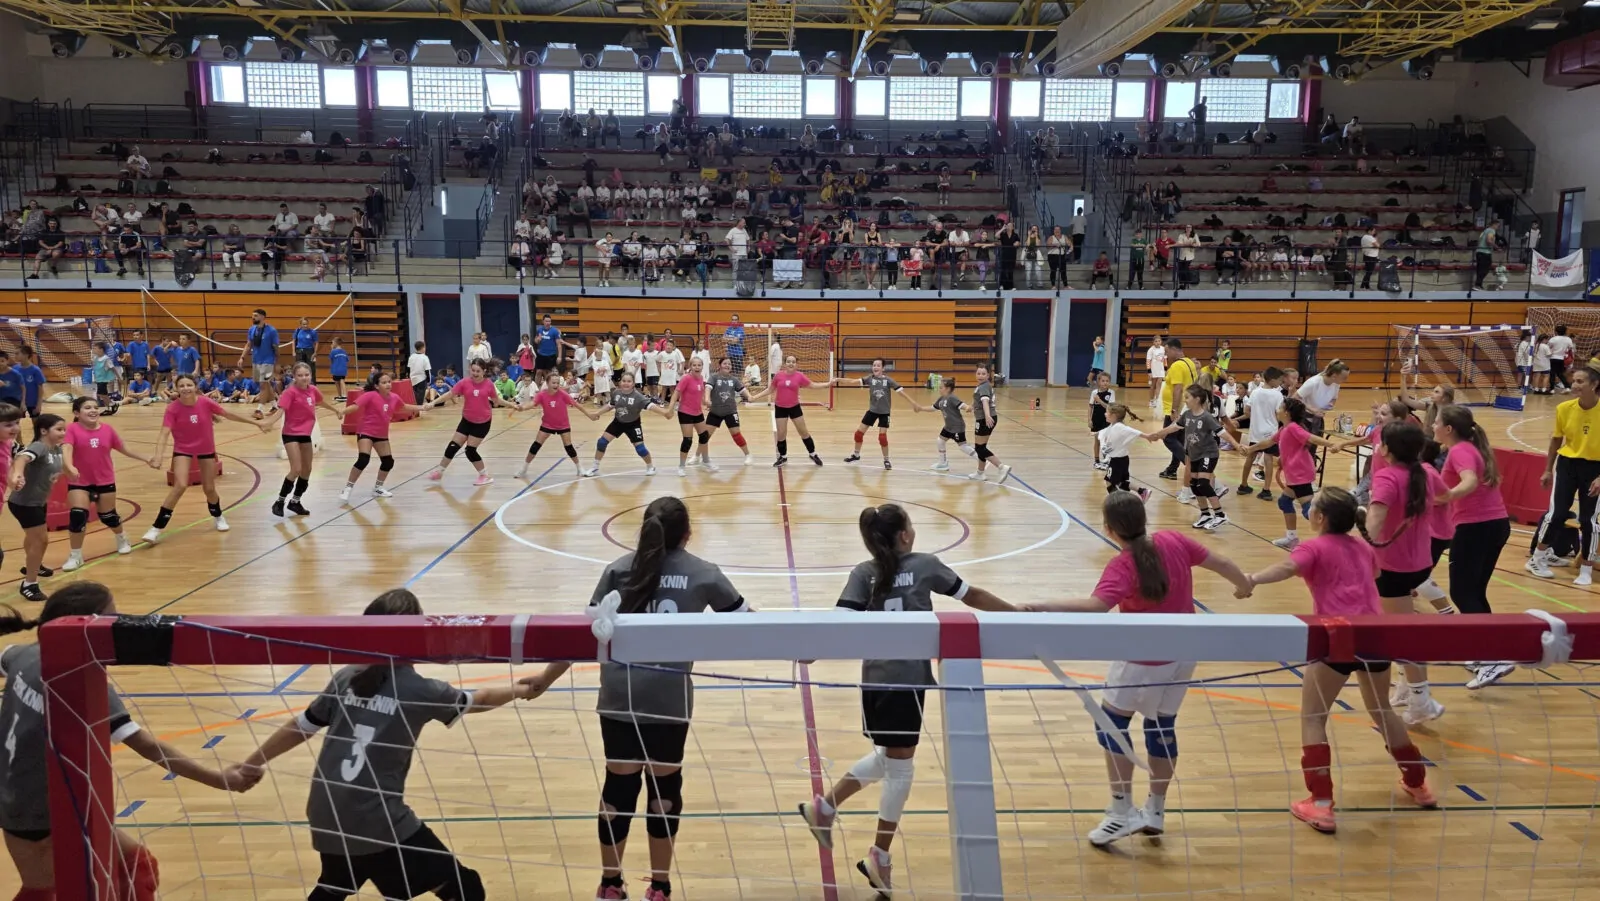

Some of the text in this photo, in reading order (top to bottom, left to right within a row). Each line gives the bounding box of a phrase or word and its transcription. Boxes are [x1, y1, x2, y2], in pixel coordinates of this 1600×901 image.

[1196, 420, 1203, 429] 9
[1203, 457, 1210, 465] 9
[659, 575, 688, 589] KNIN
[893, 572, 913, 587] NIN
[5, 712, 19, 764] 4
[341, 724, 376, 782] 3
